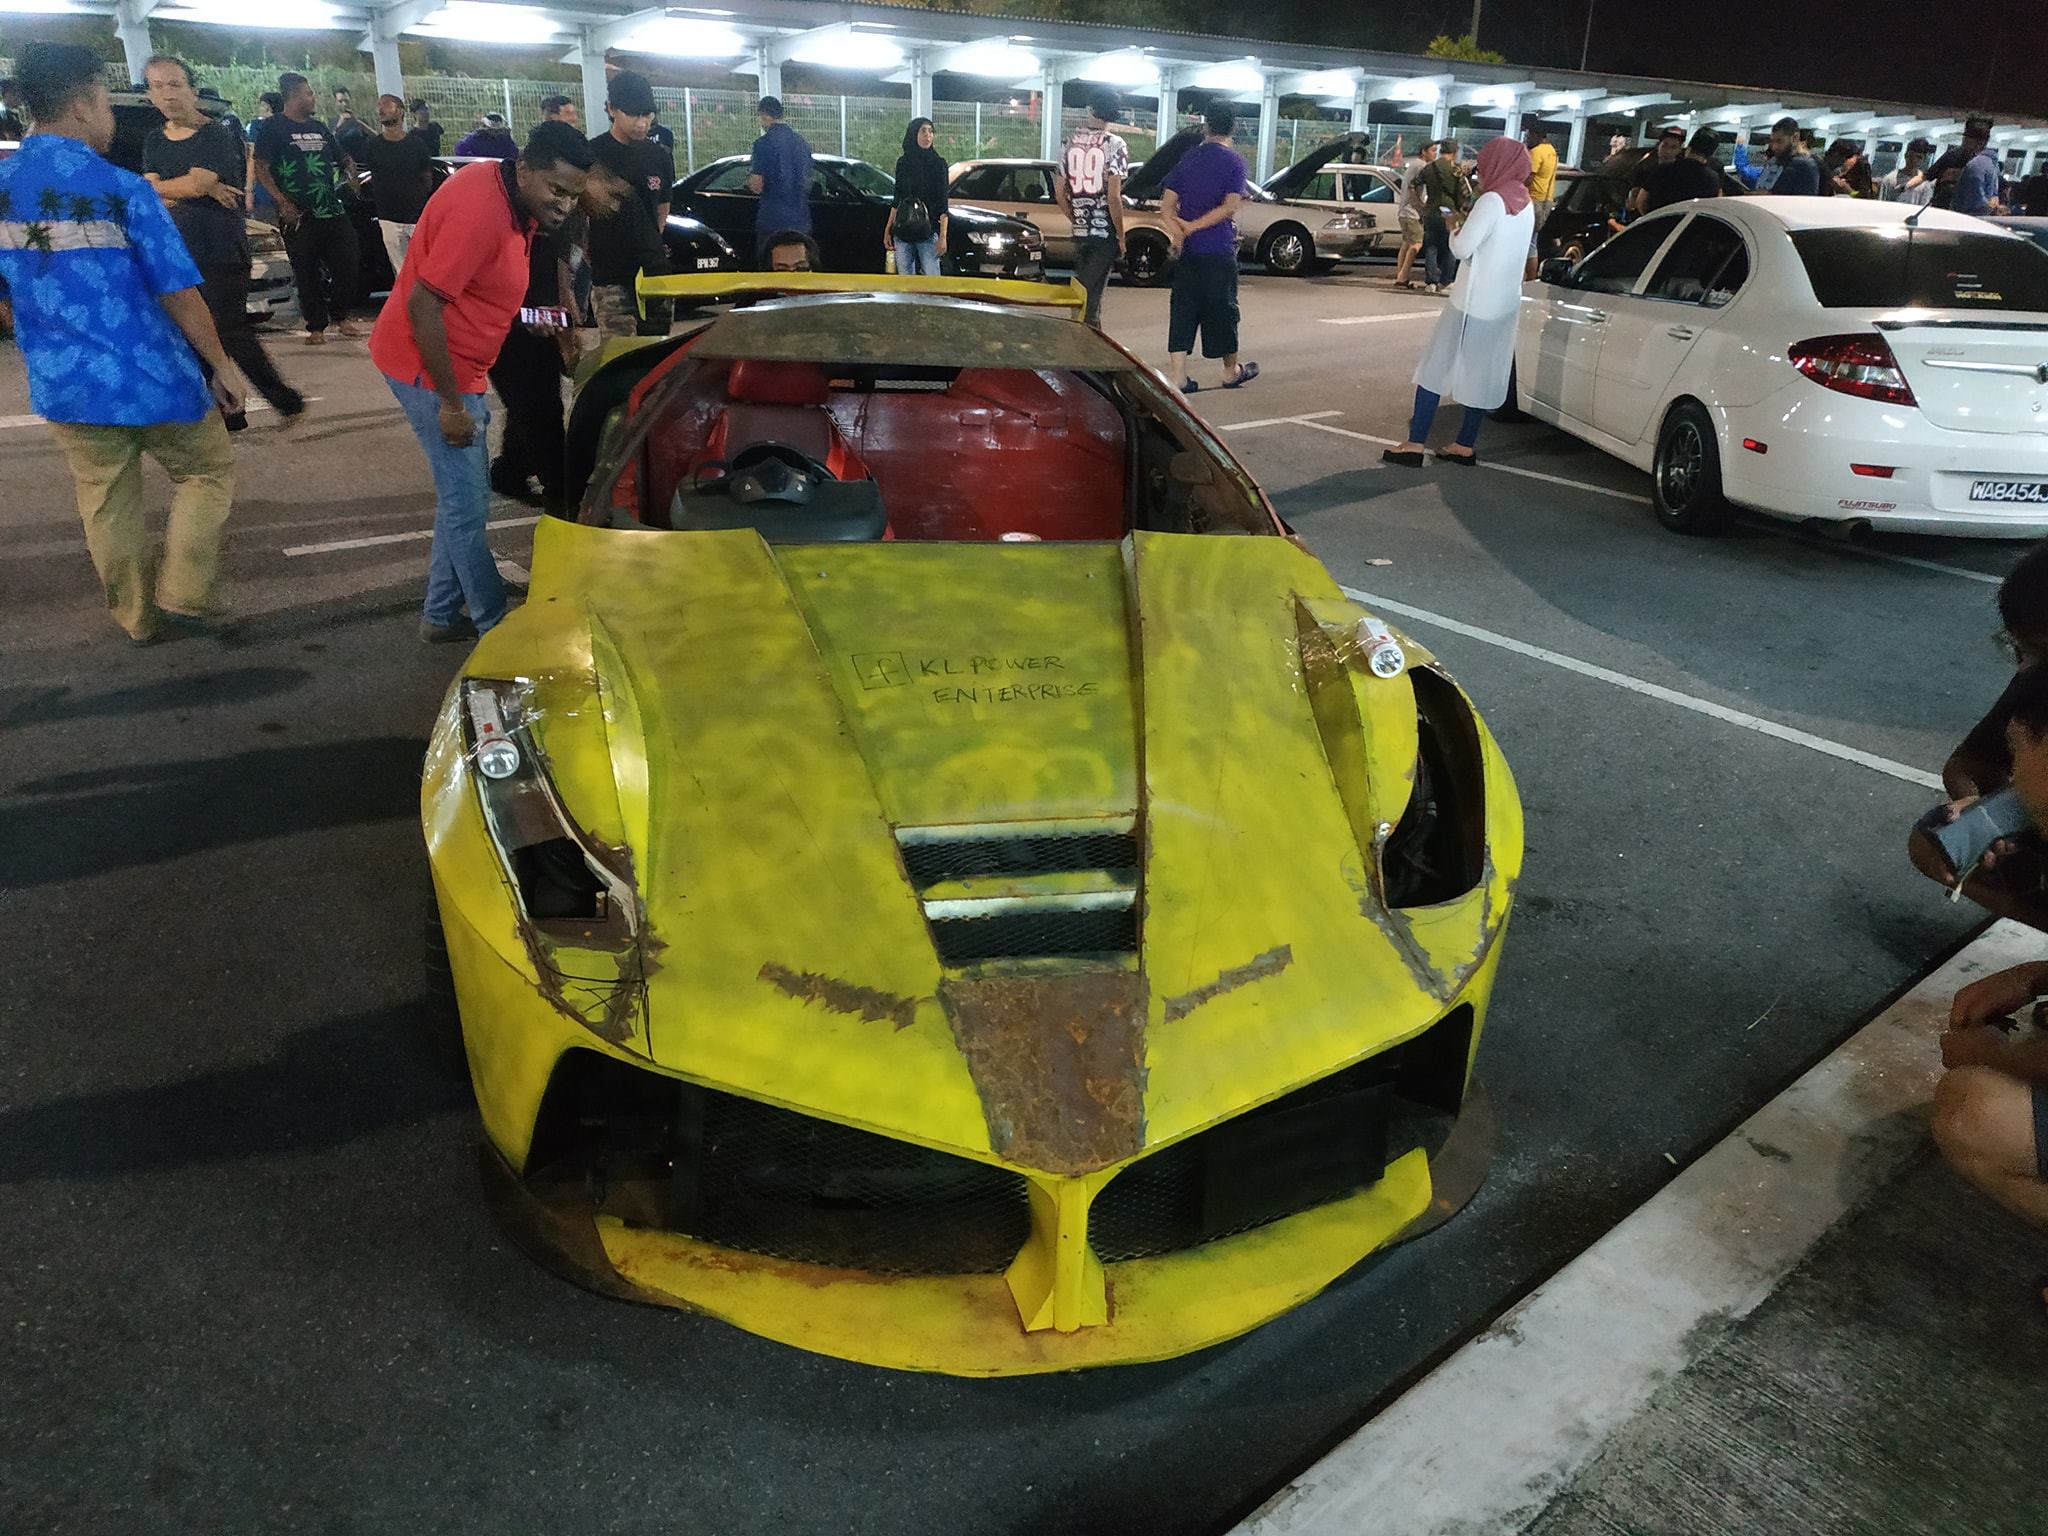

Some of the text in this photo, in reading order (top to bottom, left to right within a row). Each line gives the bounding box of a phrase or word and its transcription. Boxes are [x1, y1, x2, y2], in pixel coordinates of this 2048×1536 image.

[1068, 147, 1104, 194] 99
[1838, 499, 1897, 510] FUJITSUBO
[920, 659, 964, 675] KL
[970, 655, 1065, 675] POWER
[932, 682, 1097, 703] ENTERPRISE
